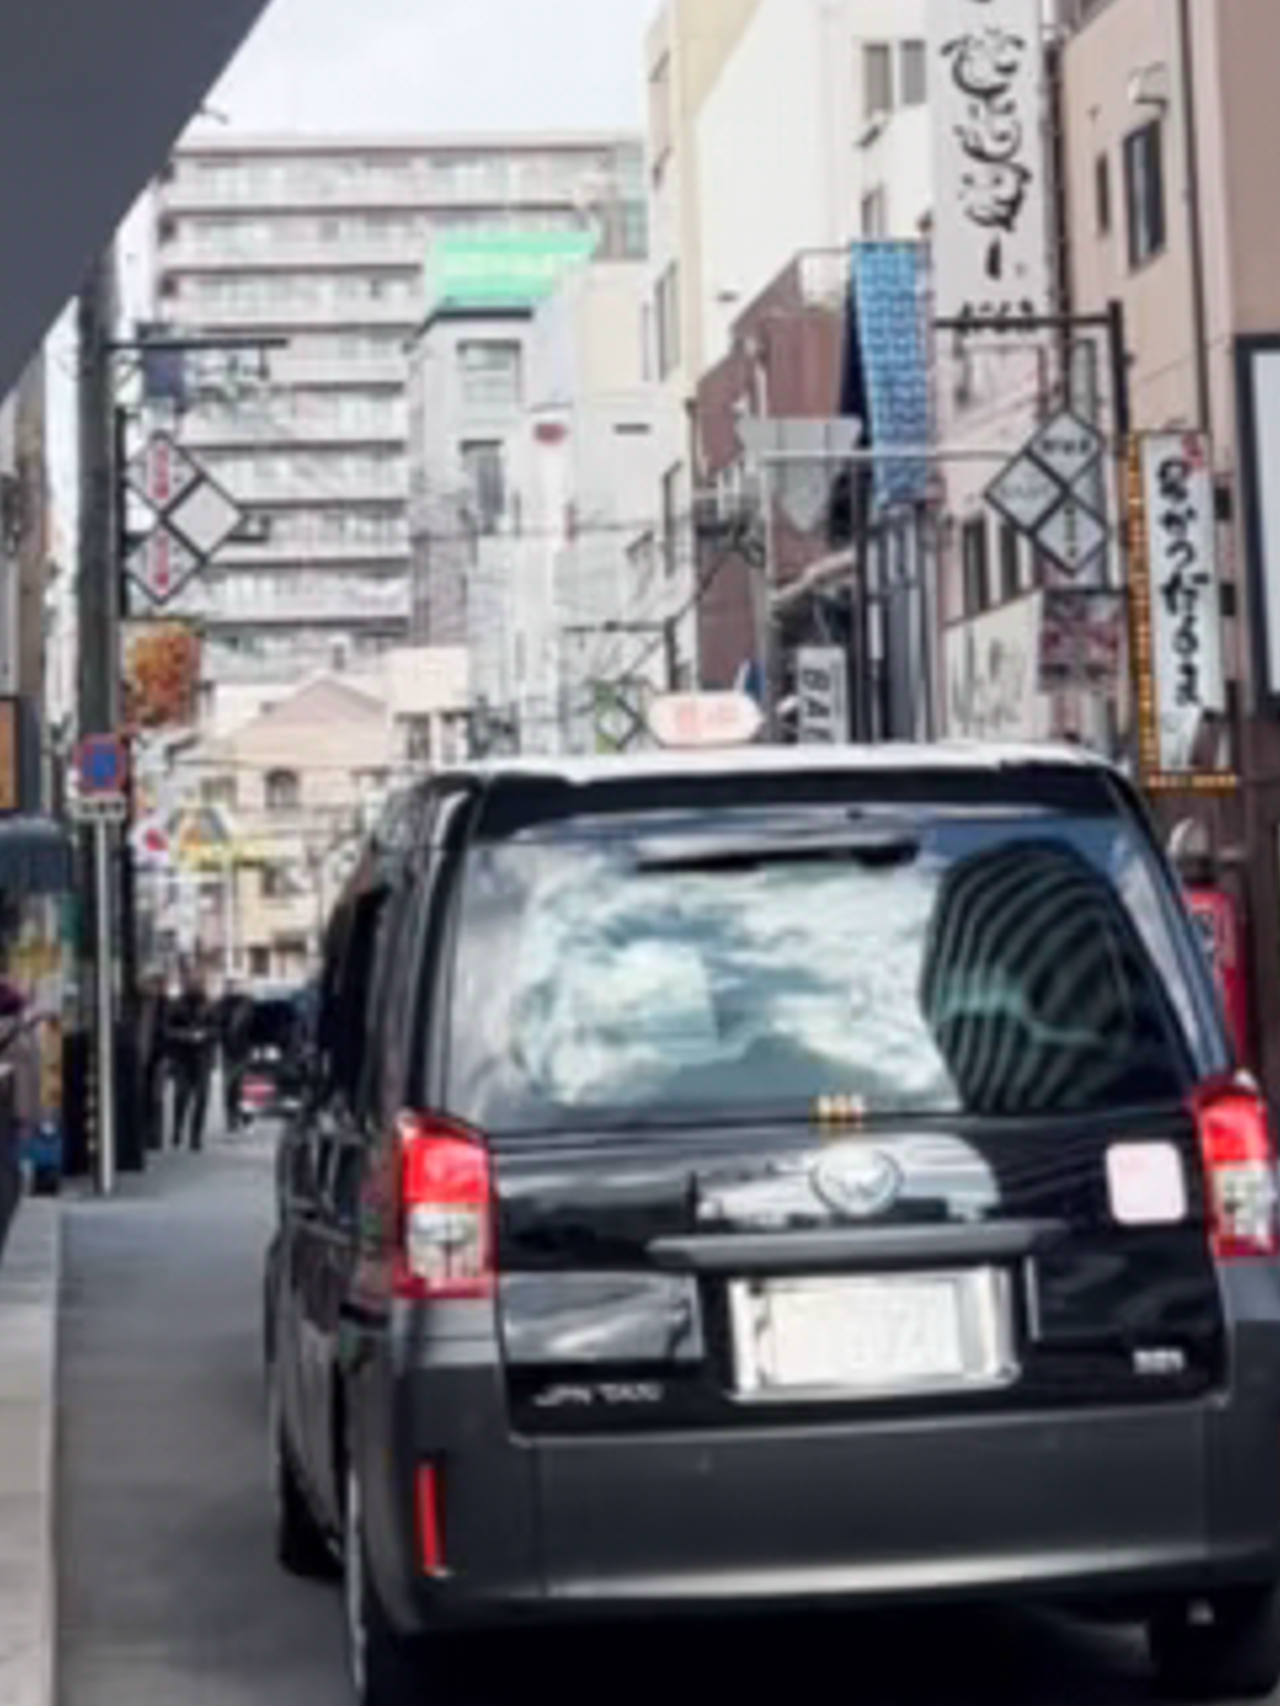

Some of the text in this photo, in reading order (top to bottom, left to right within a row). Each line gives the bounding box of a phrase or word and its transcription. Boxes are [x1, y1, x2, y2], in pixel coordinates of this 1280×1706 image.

[1157, 458, 1210, 710] 串かつだるま
